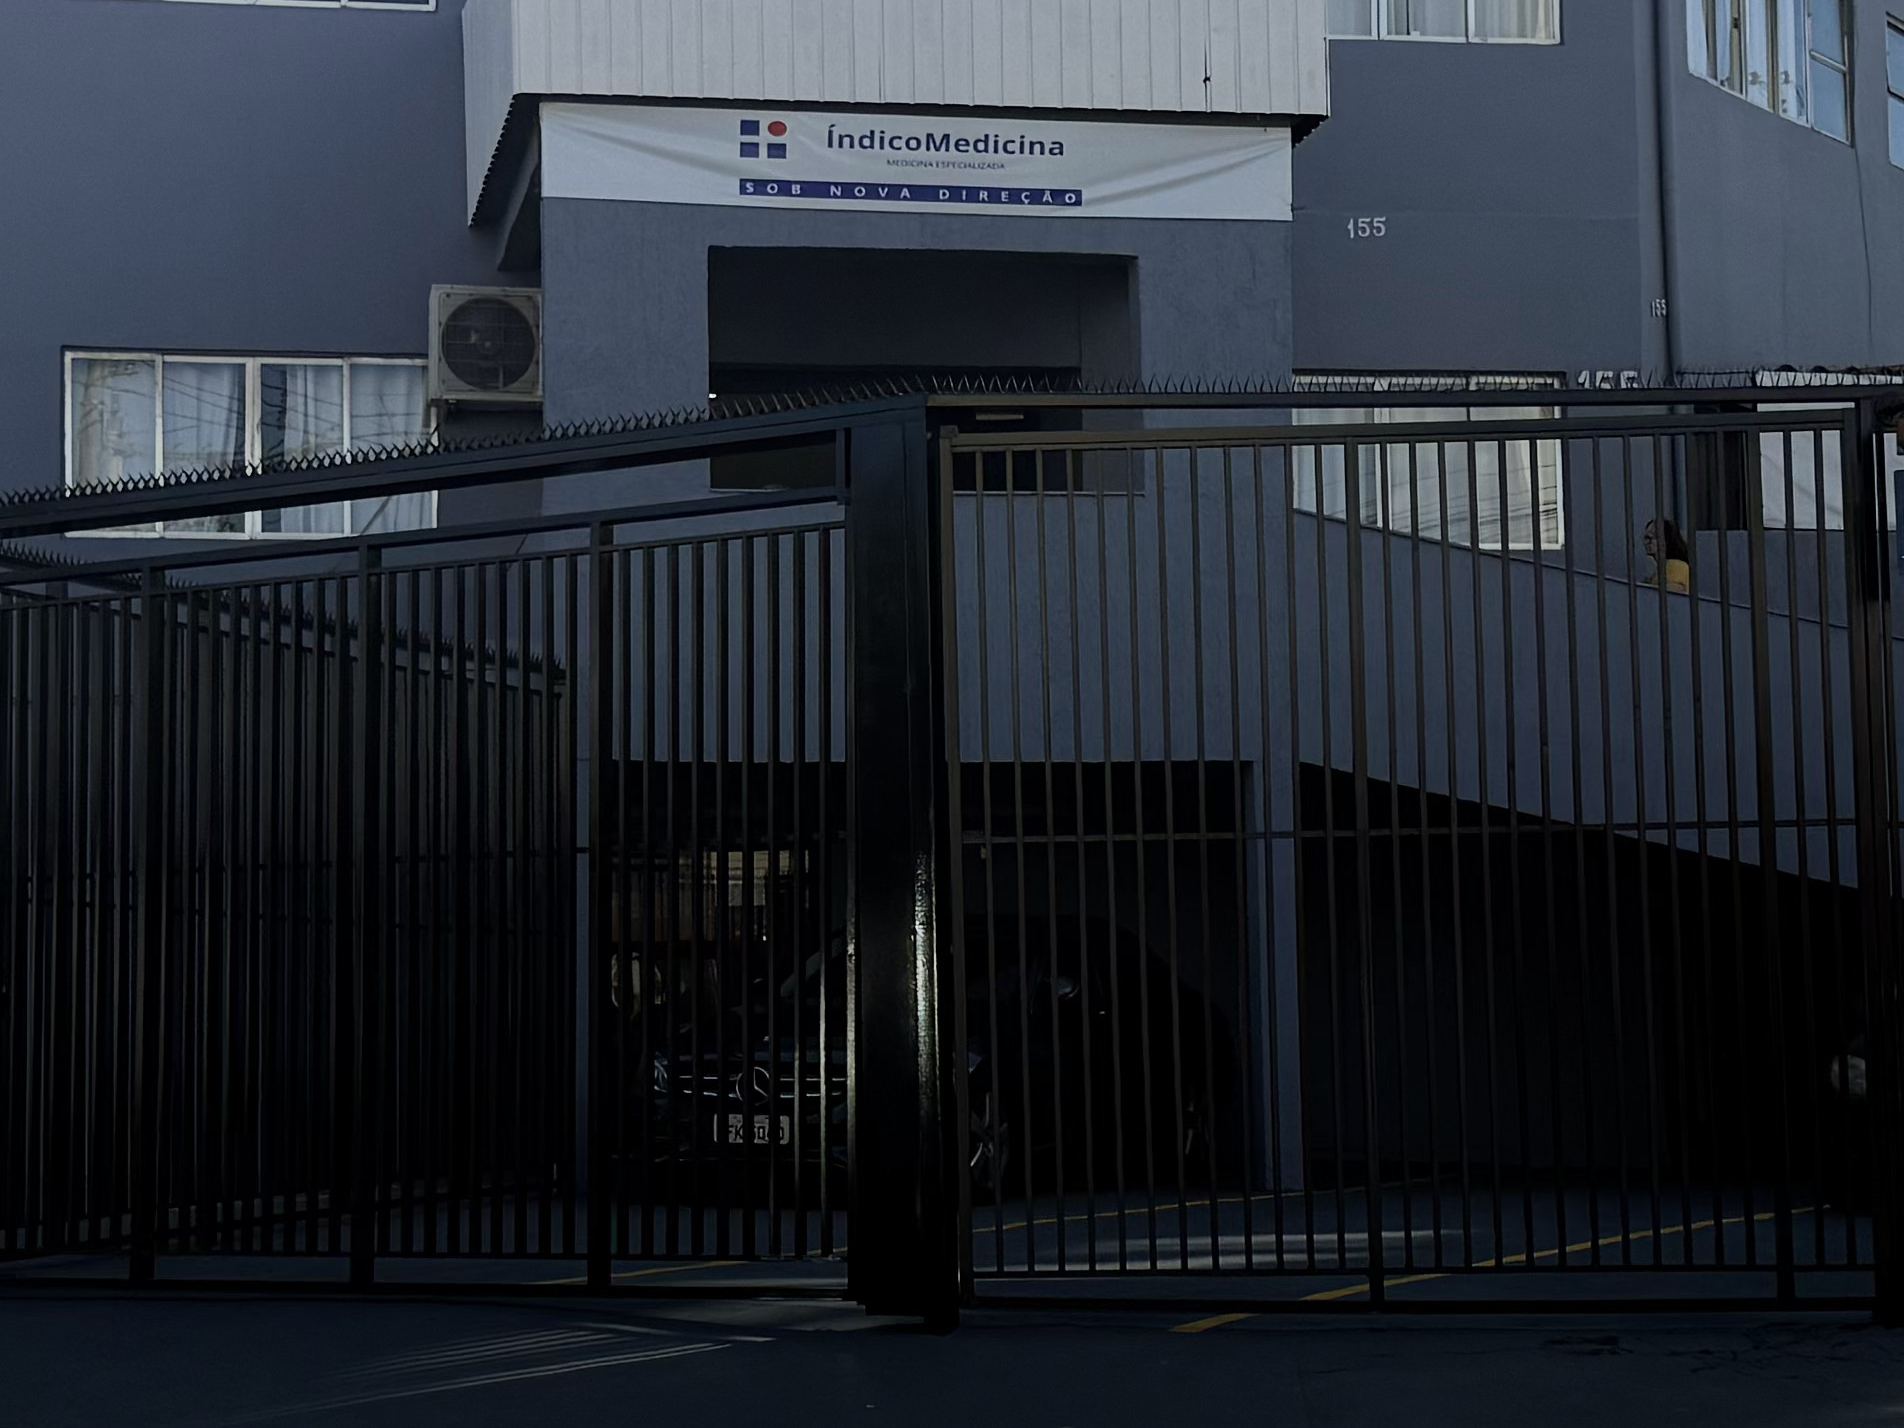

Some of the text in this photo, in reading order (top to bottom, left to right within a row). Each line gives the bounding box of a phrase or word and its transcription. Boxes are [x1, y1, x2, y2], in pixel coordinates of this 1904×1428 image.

[827, 124, 1065, 157] ÍndicoMedicina
[745, 181, 1077, 206] SOB NOVA DIREÇÃO
[1347, 216, 1387, 239] 155
[1651, 298, 1667, 317] 155
